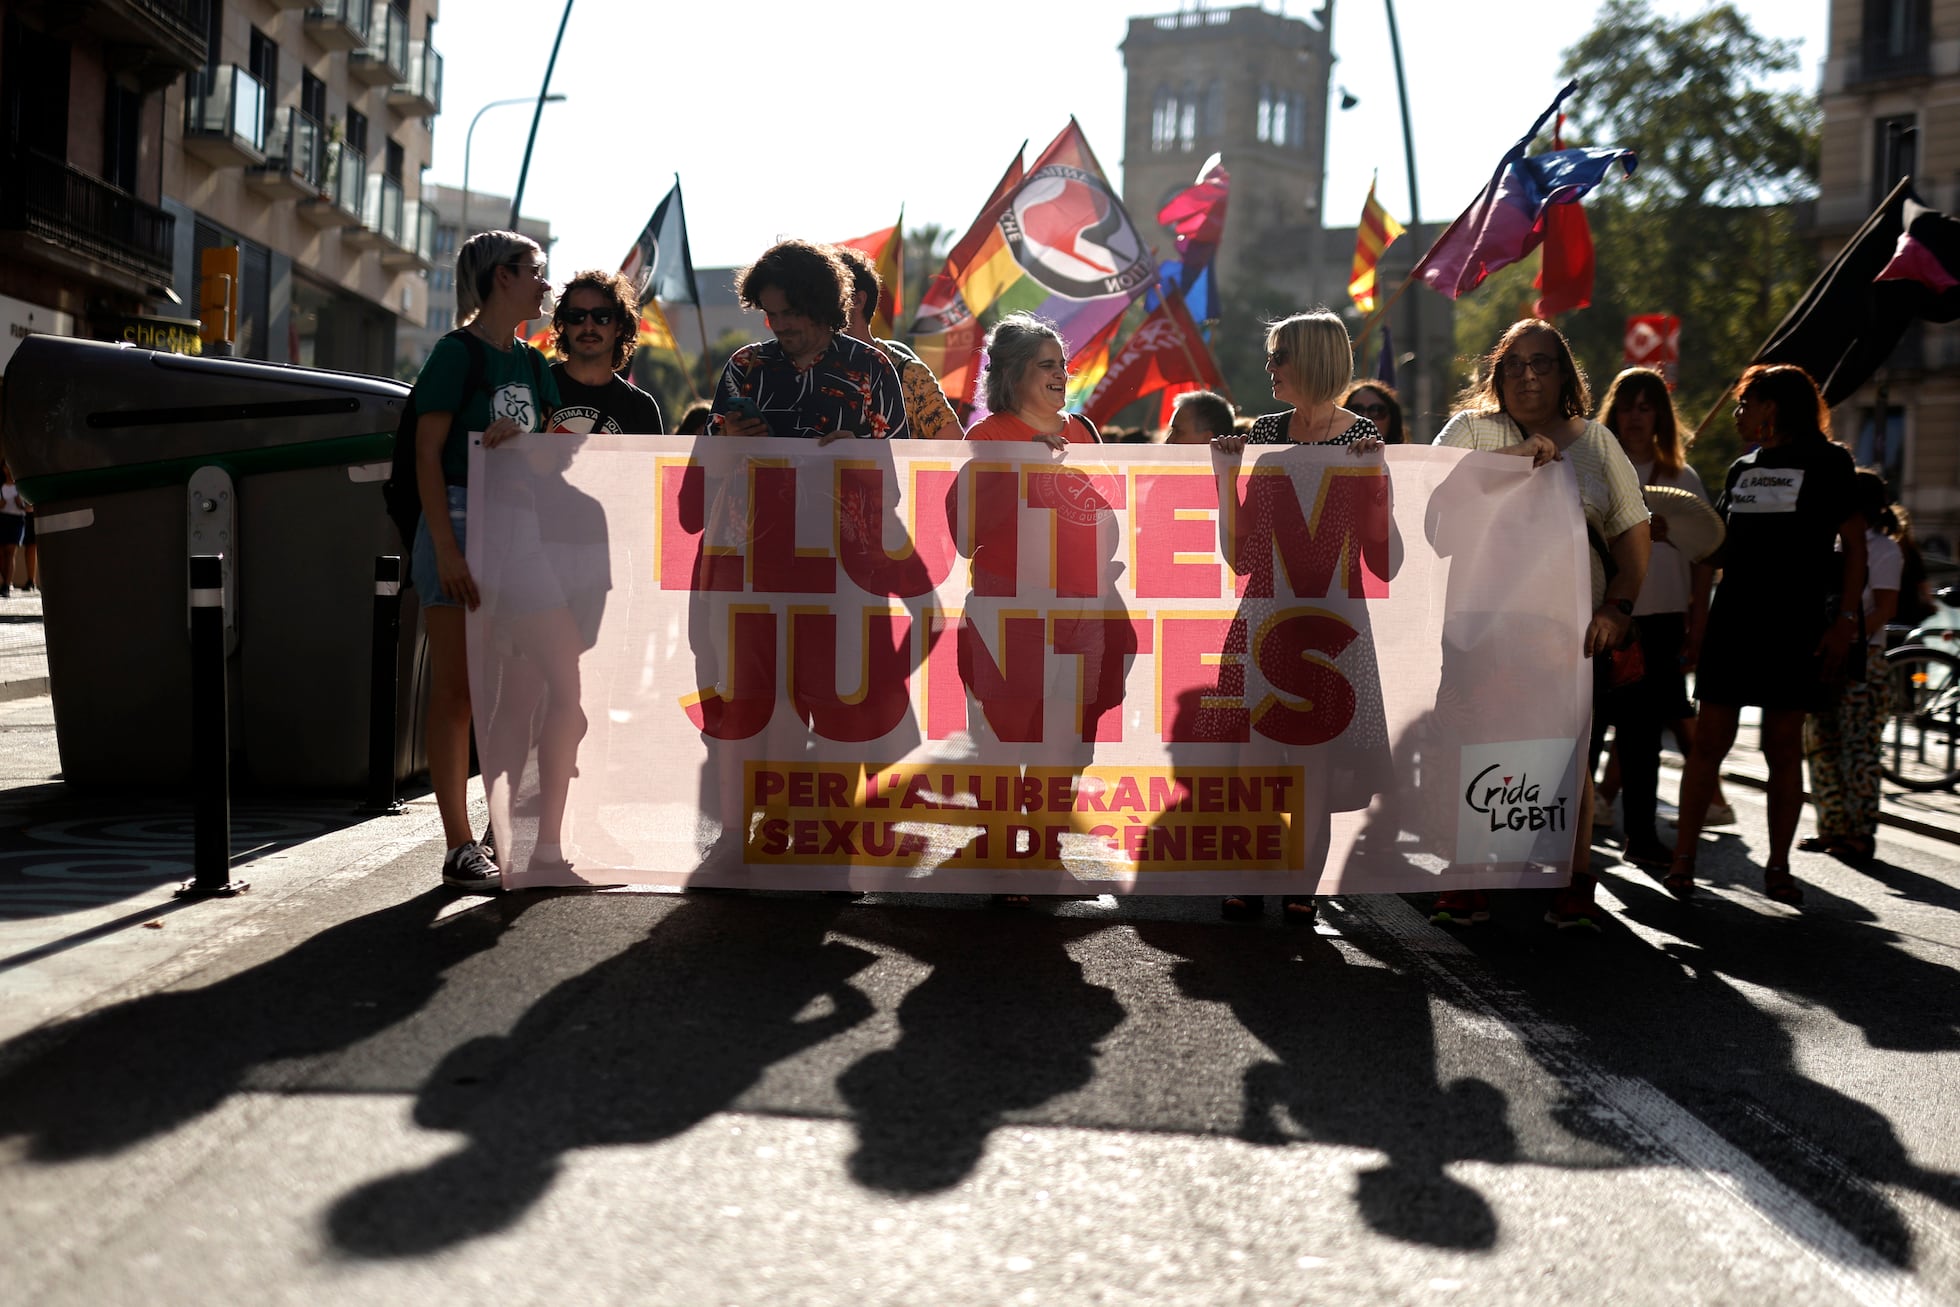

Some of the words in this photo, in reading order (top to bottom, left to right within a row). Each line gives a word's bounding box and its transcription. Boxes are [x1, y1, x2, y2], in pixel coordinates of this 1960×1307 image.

[553, 409, 583, 423] STIMA
[654, 456, 1389, 599] LLUTEM
[678, 604, 1360, 745] JUNTES
[754, 771, 850, 807] PER
[865, 773, 1293, 812] L'ALLIBERAMENT
[1465, 763, 1540, 813] Crida
[761, 818, 961, 858] SEXUA
